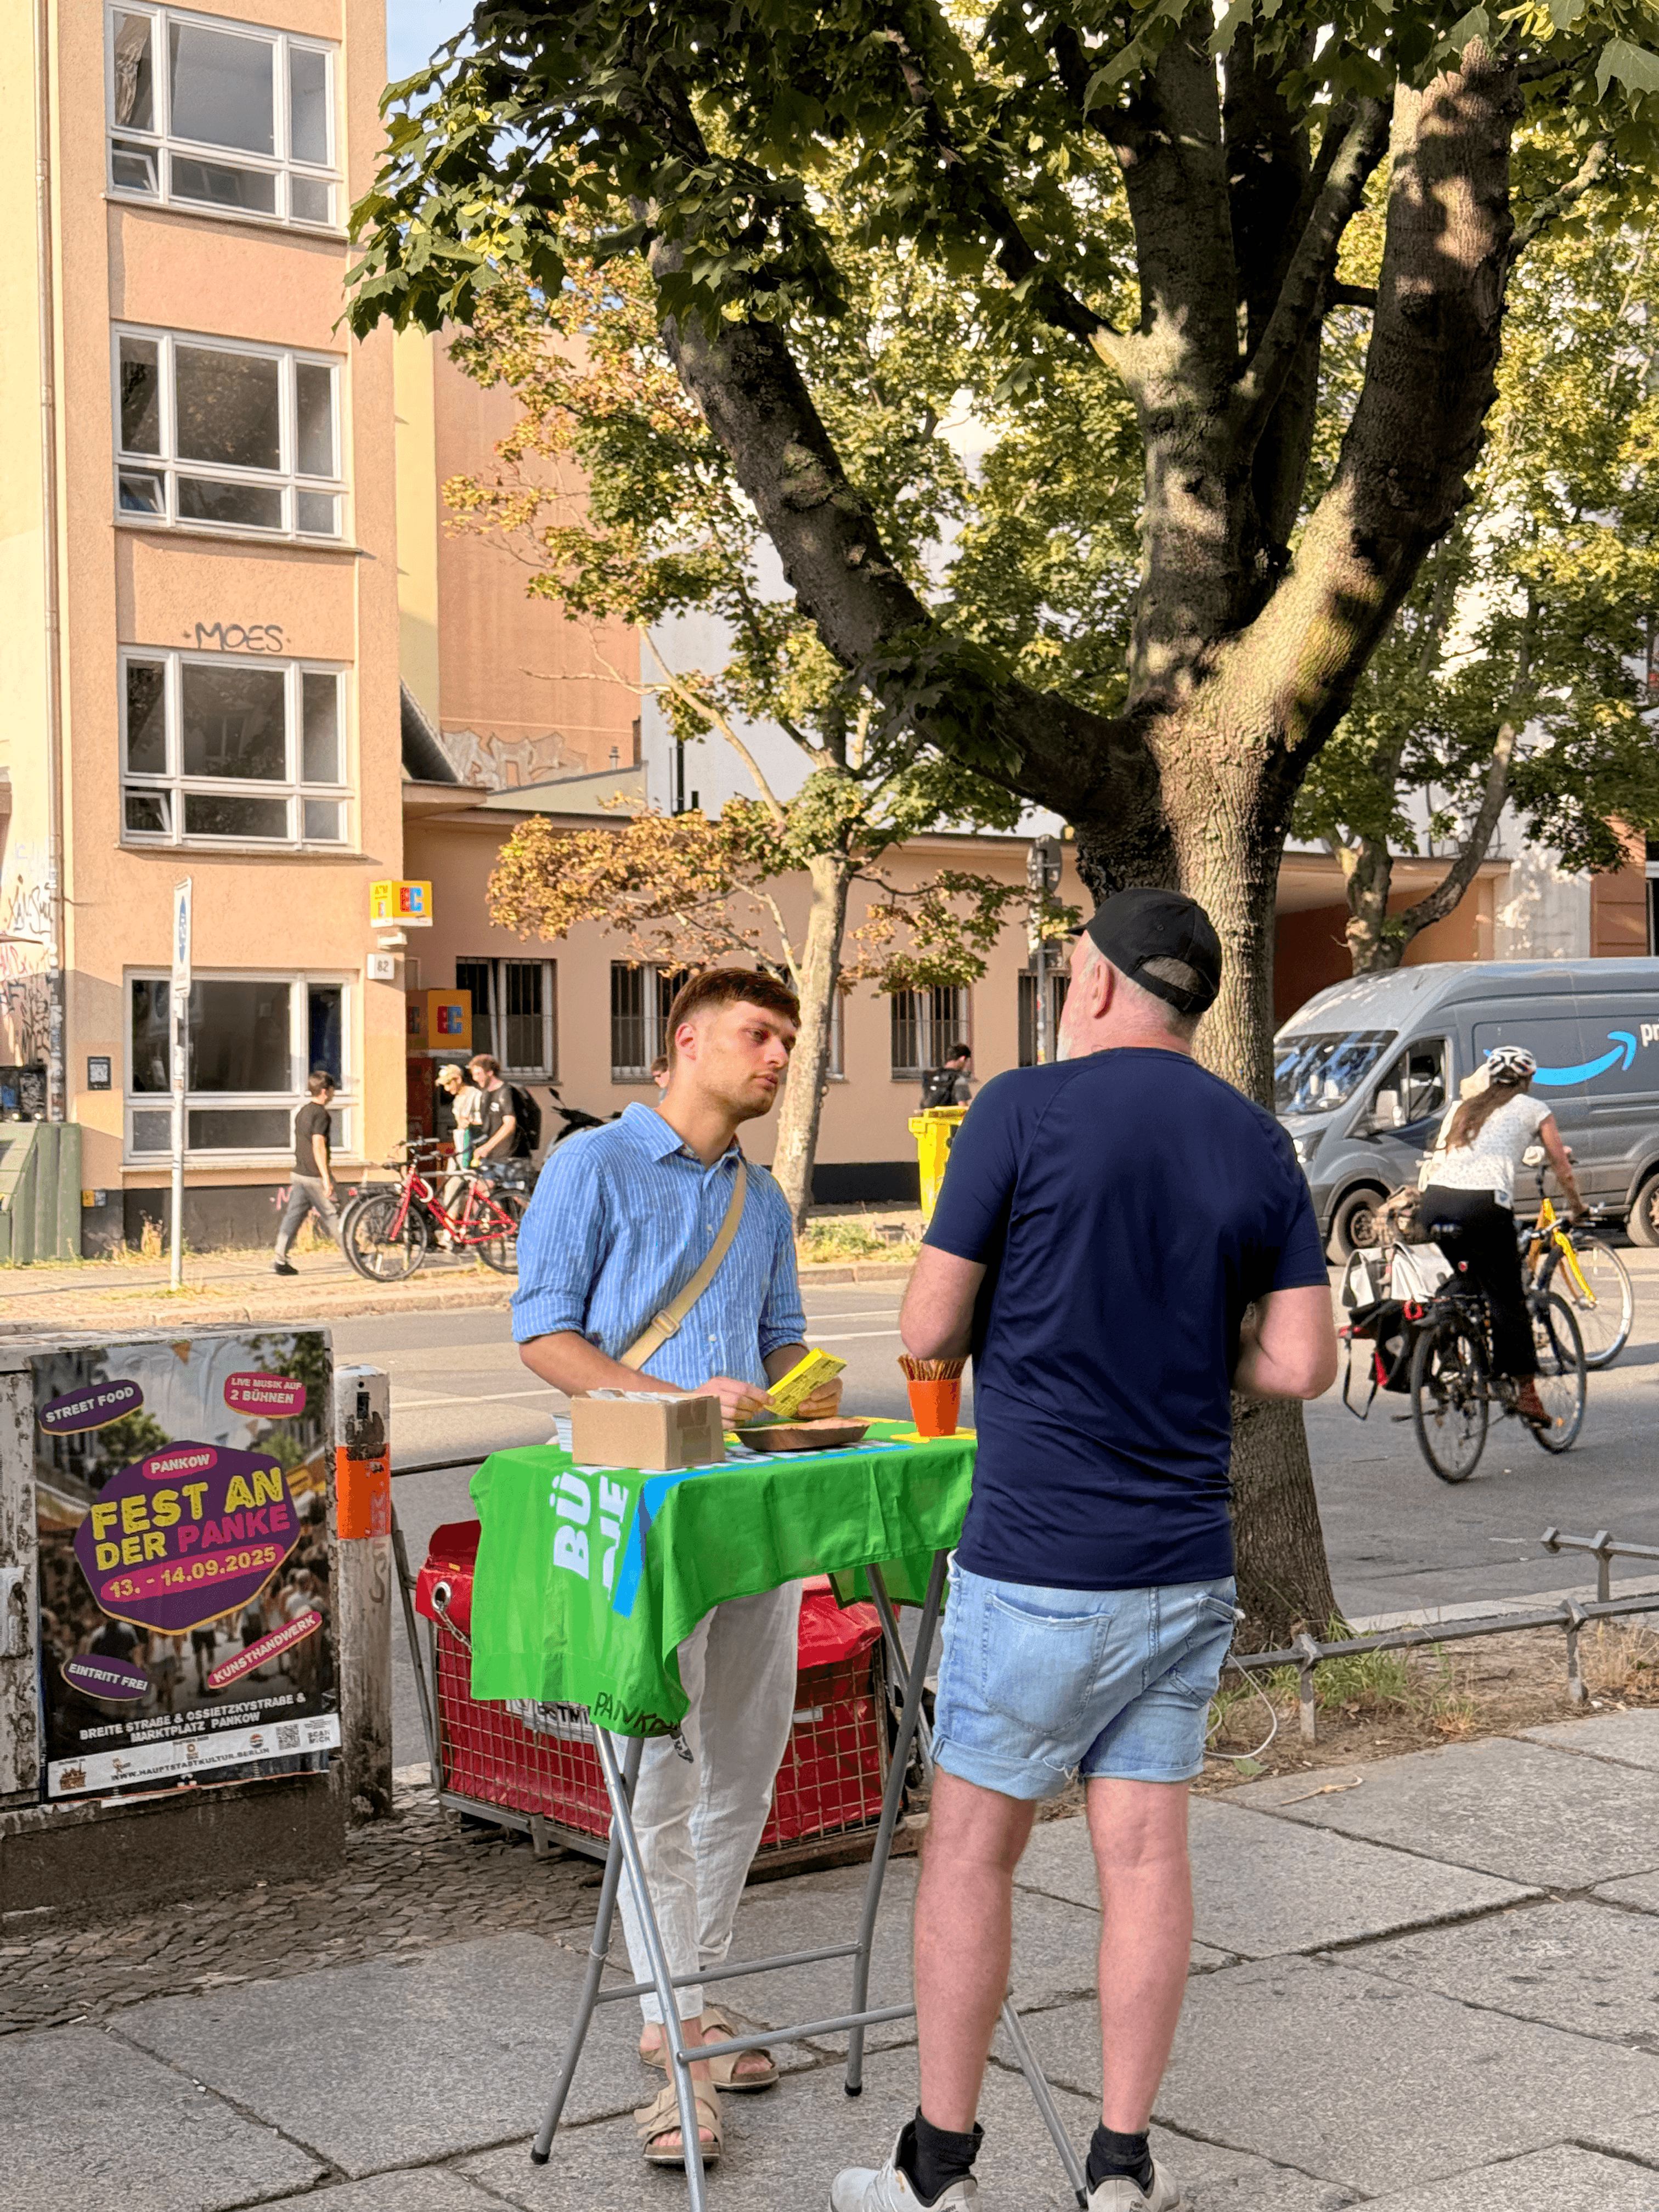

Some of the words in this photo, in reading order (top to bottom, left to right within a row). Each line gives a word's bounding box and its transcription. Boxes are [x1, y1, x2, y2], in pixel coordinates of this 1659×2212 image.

[229, 1389, 239, 1401] 2
[242, 1389, 294, 1404] BÜHNEN
[231, 1378, 251, 1386] LIVE
[252, 1379, 283, 1389] MUSIK
[284, 1381, 302, 1390] AUF
[46, 1398, 94, 1423] STREET
[97, 1386, 134, 1407] FOOD
[150, 1453, 211, 1474] PANKOW
[91, 1482, 208, 1541] FEST
[224, 1466, 284, 1514] AN
[94, 1531, 168, 1571] DER
[178, 1504, 291, 1553] PANKE
[110, 1579, 141, 1599] 13.
[161, 1545, 276, 1587] 14.09.2025
[212, 1613, 317, 1684] KUNSTHANDWERK
[68, 1663, 121, 1684] EINTRITT
[121, 1675, 149, 1691] FREI
[79, 1723, 123, 1740] BREITE
[173, 1713, 184, 1723] &
[296, 1693, 306, 1703] &
[130, 1720, 206, 1743] MARKTPLATZ
[211, 1711, 262, 1729] PANKOW
